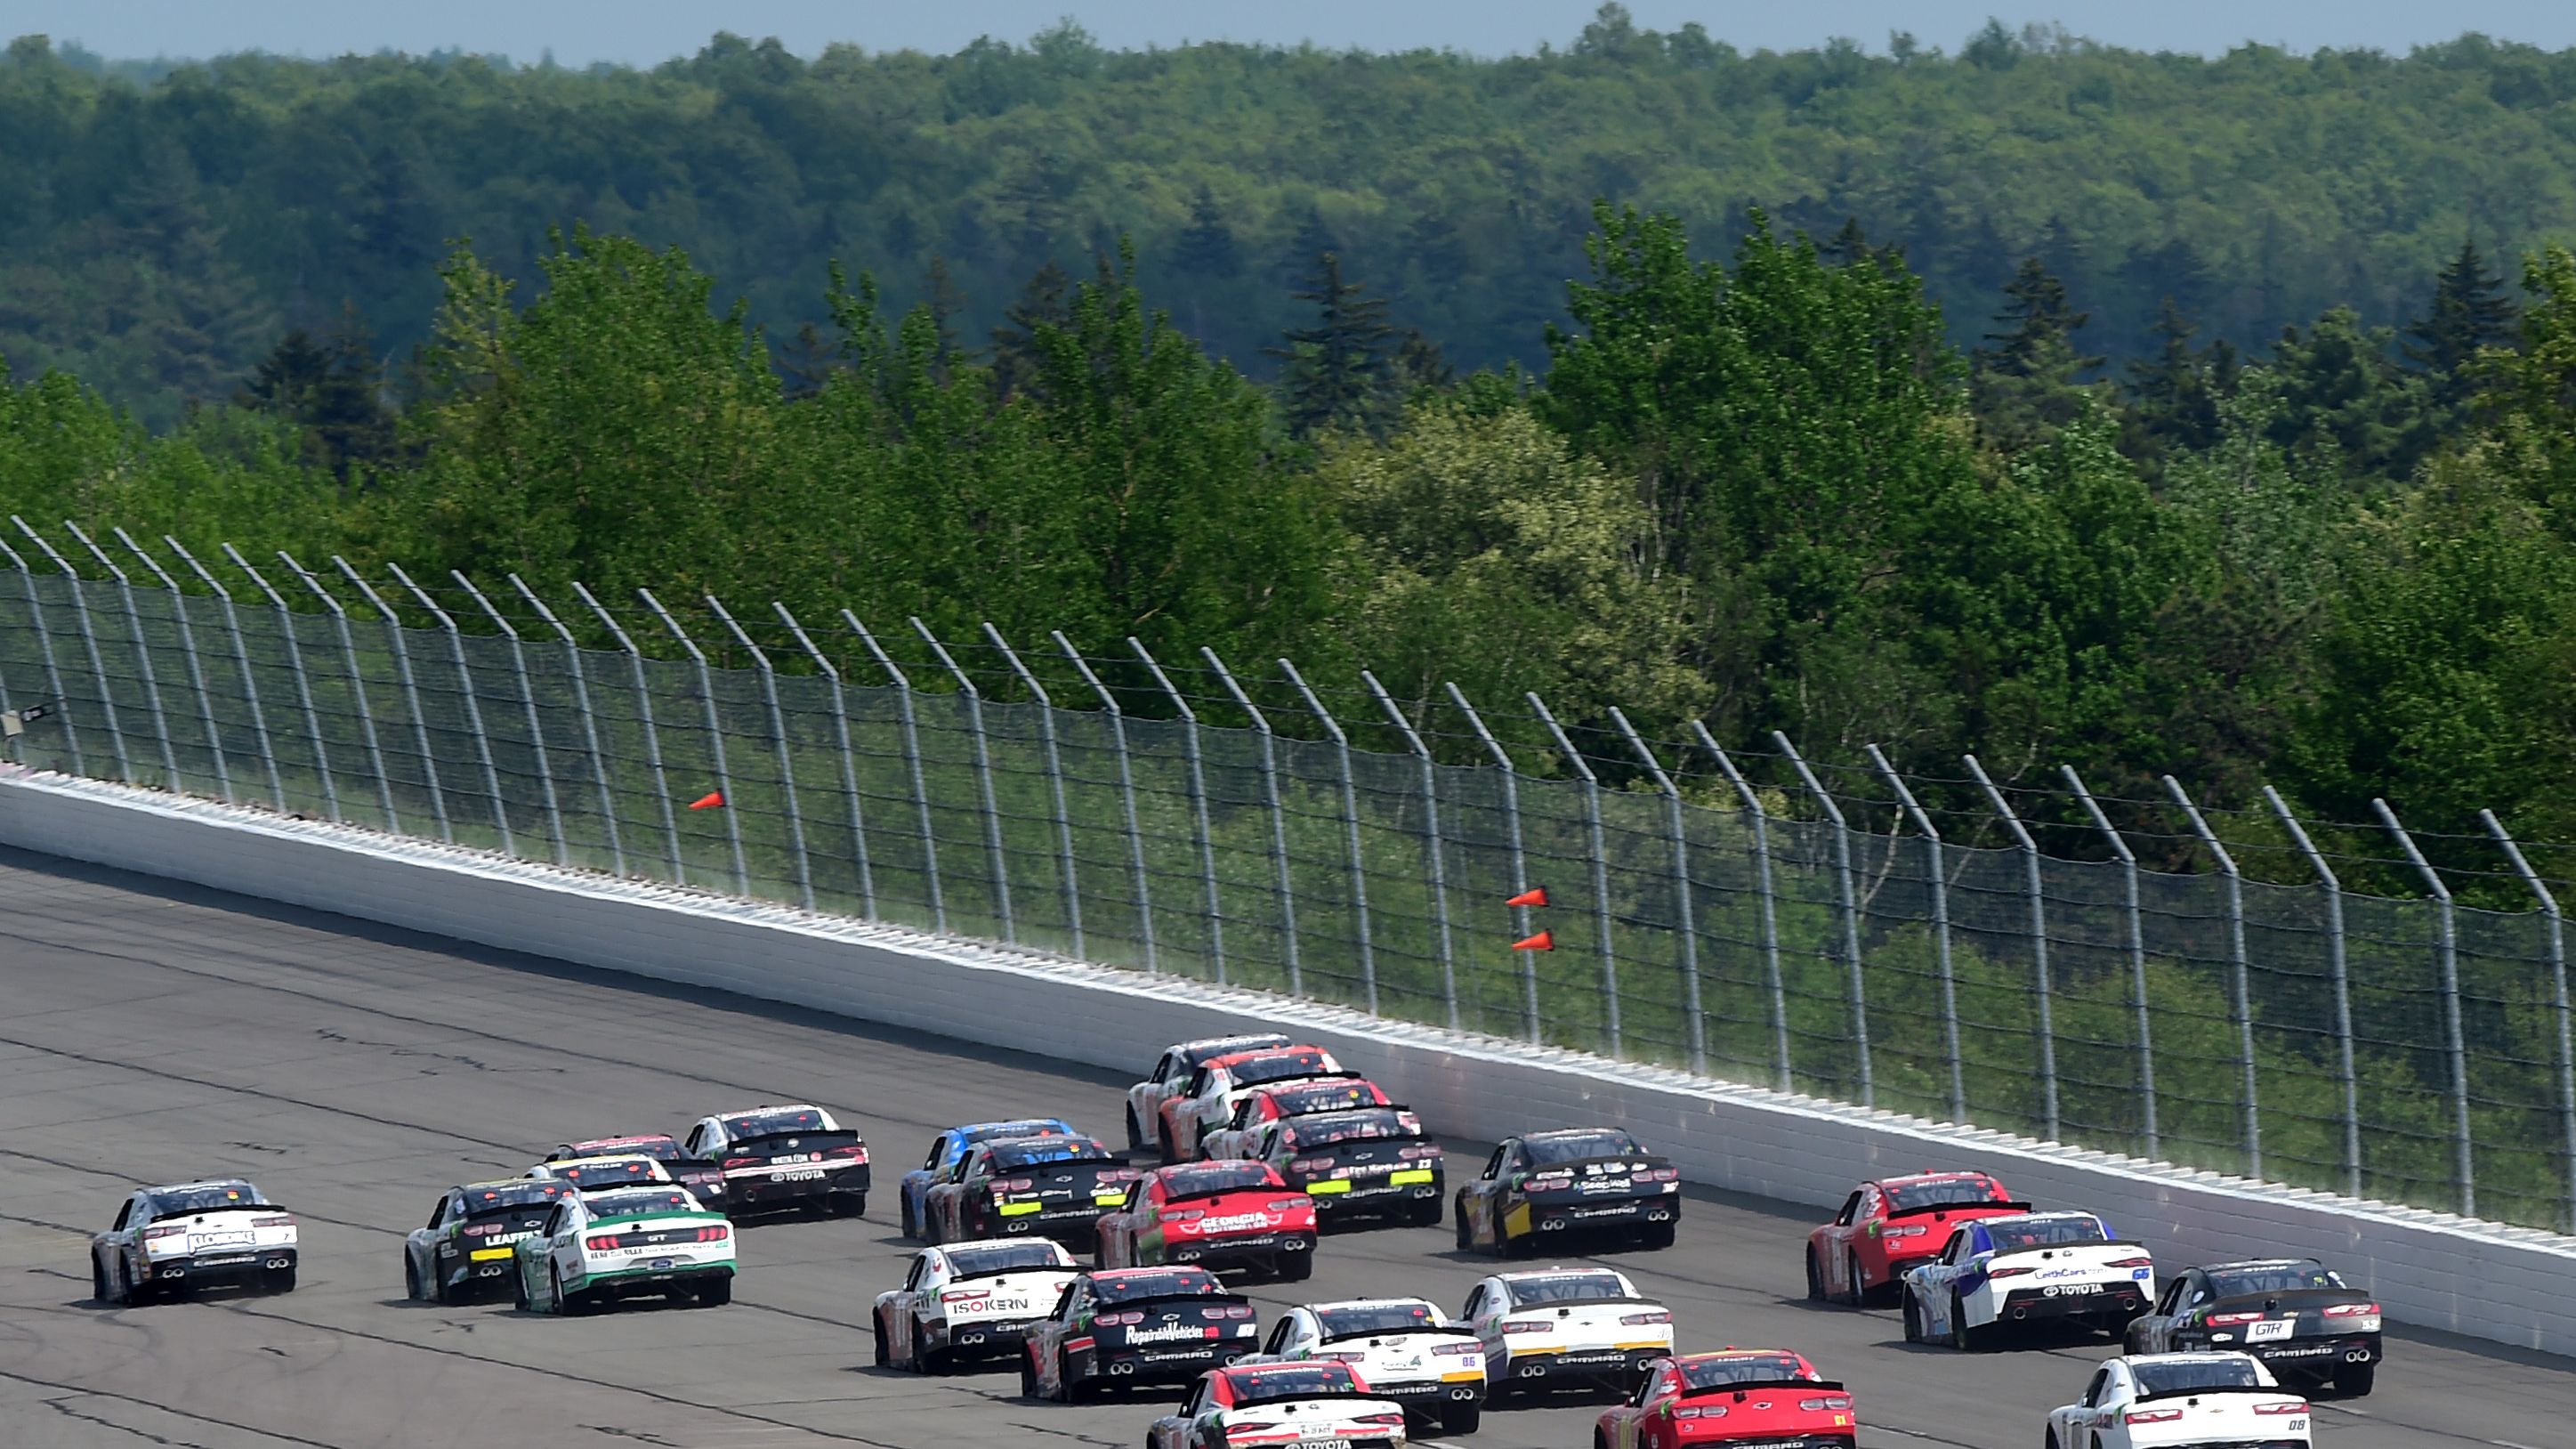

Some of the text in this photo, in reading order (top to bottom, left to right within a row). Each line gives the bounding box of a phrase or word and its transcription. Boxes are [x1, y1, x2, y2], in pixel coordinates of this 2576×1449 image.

[785, 1170, 826, 1181] TOYOTA
[1201, 1211, 1267, 1228] GEORGIA
[2059, 1283, 2105, 1296] TOYOTA
[953, 1298, 1029, 1315] ISOKERN
[2256, 1323, 2283, 1335] GTR
[1144, 1350, 1214, 1363] CAMARO
[1556, 1355, 1626, 1364] CAMARO
[2264, 1348, 2333, 1359] CAMARO
[1302, 1438, 1353, 1449] TOYOTA
